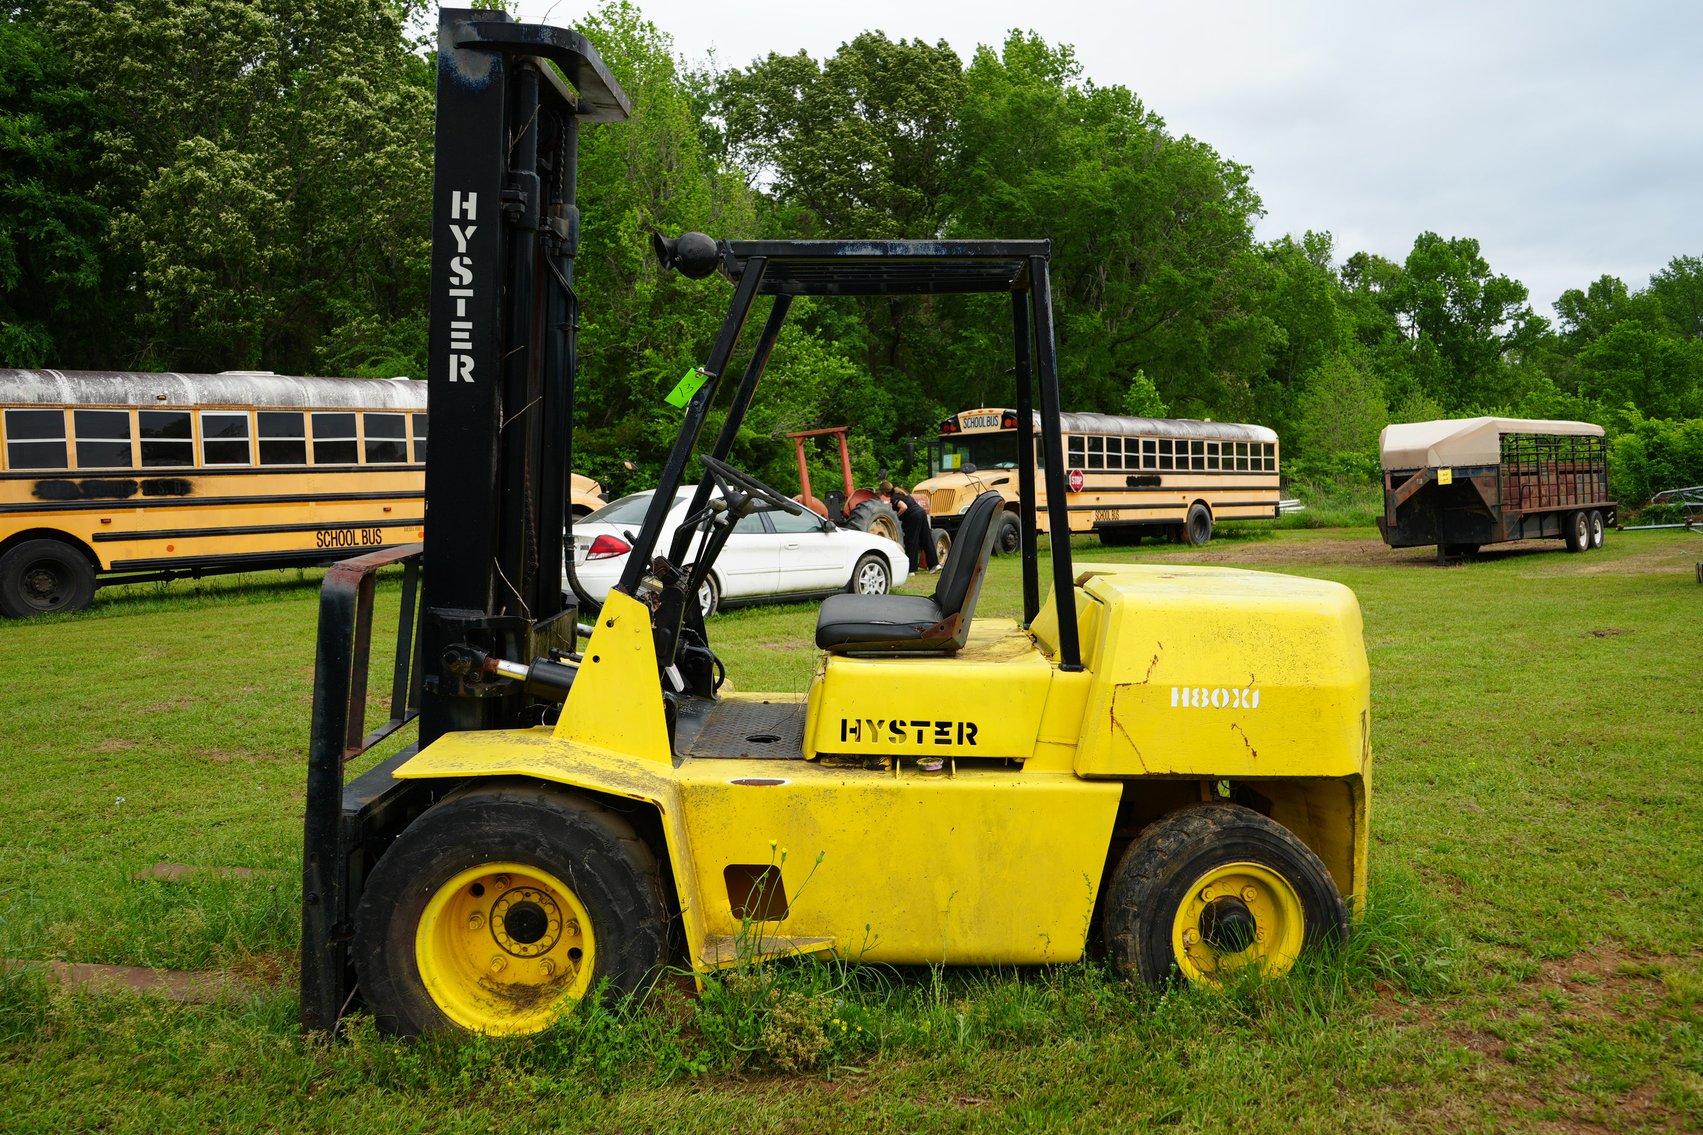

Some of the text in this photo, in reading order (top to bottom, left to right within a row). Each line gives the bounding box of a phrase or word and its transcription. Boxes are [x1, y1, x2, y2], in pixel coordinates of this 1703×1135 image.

[448, 190, 478, 383] HYSTER
[963, 415, 999, 429] SCHOOL BUS
[1071, 475, 1083, 486] STOP
[1094, 509, 1120, 521] SCHOOL BUS
[316, 528, 383, 548] SCHOOL BUS
[840, 718, 978, 746] HYSTER
